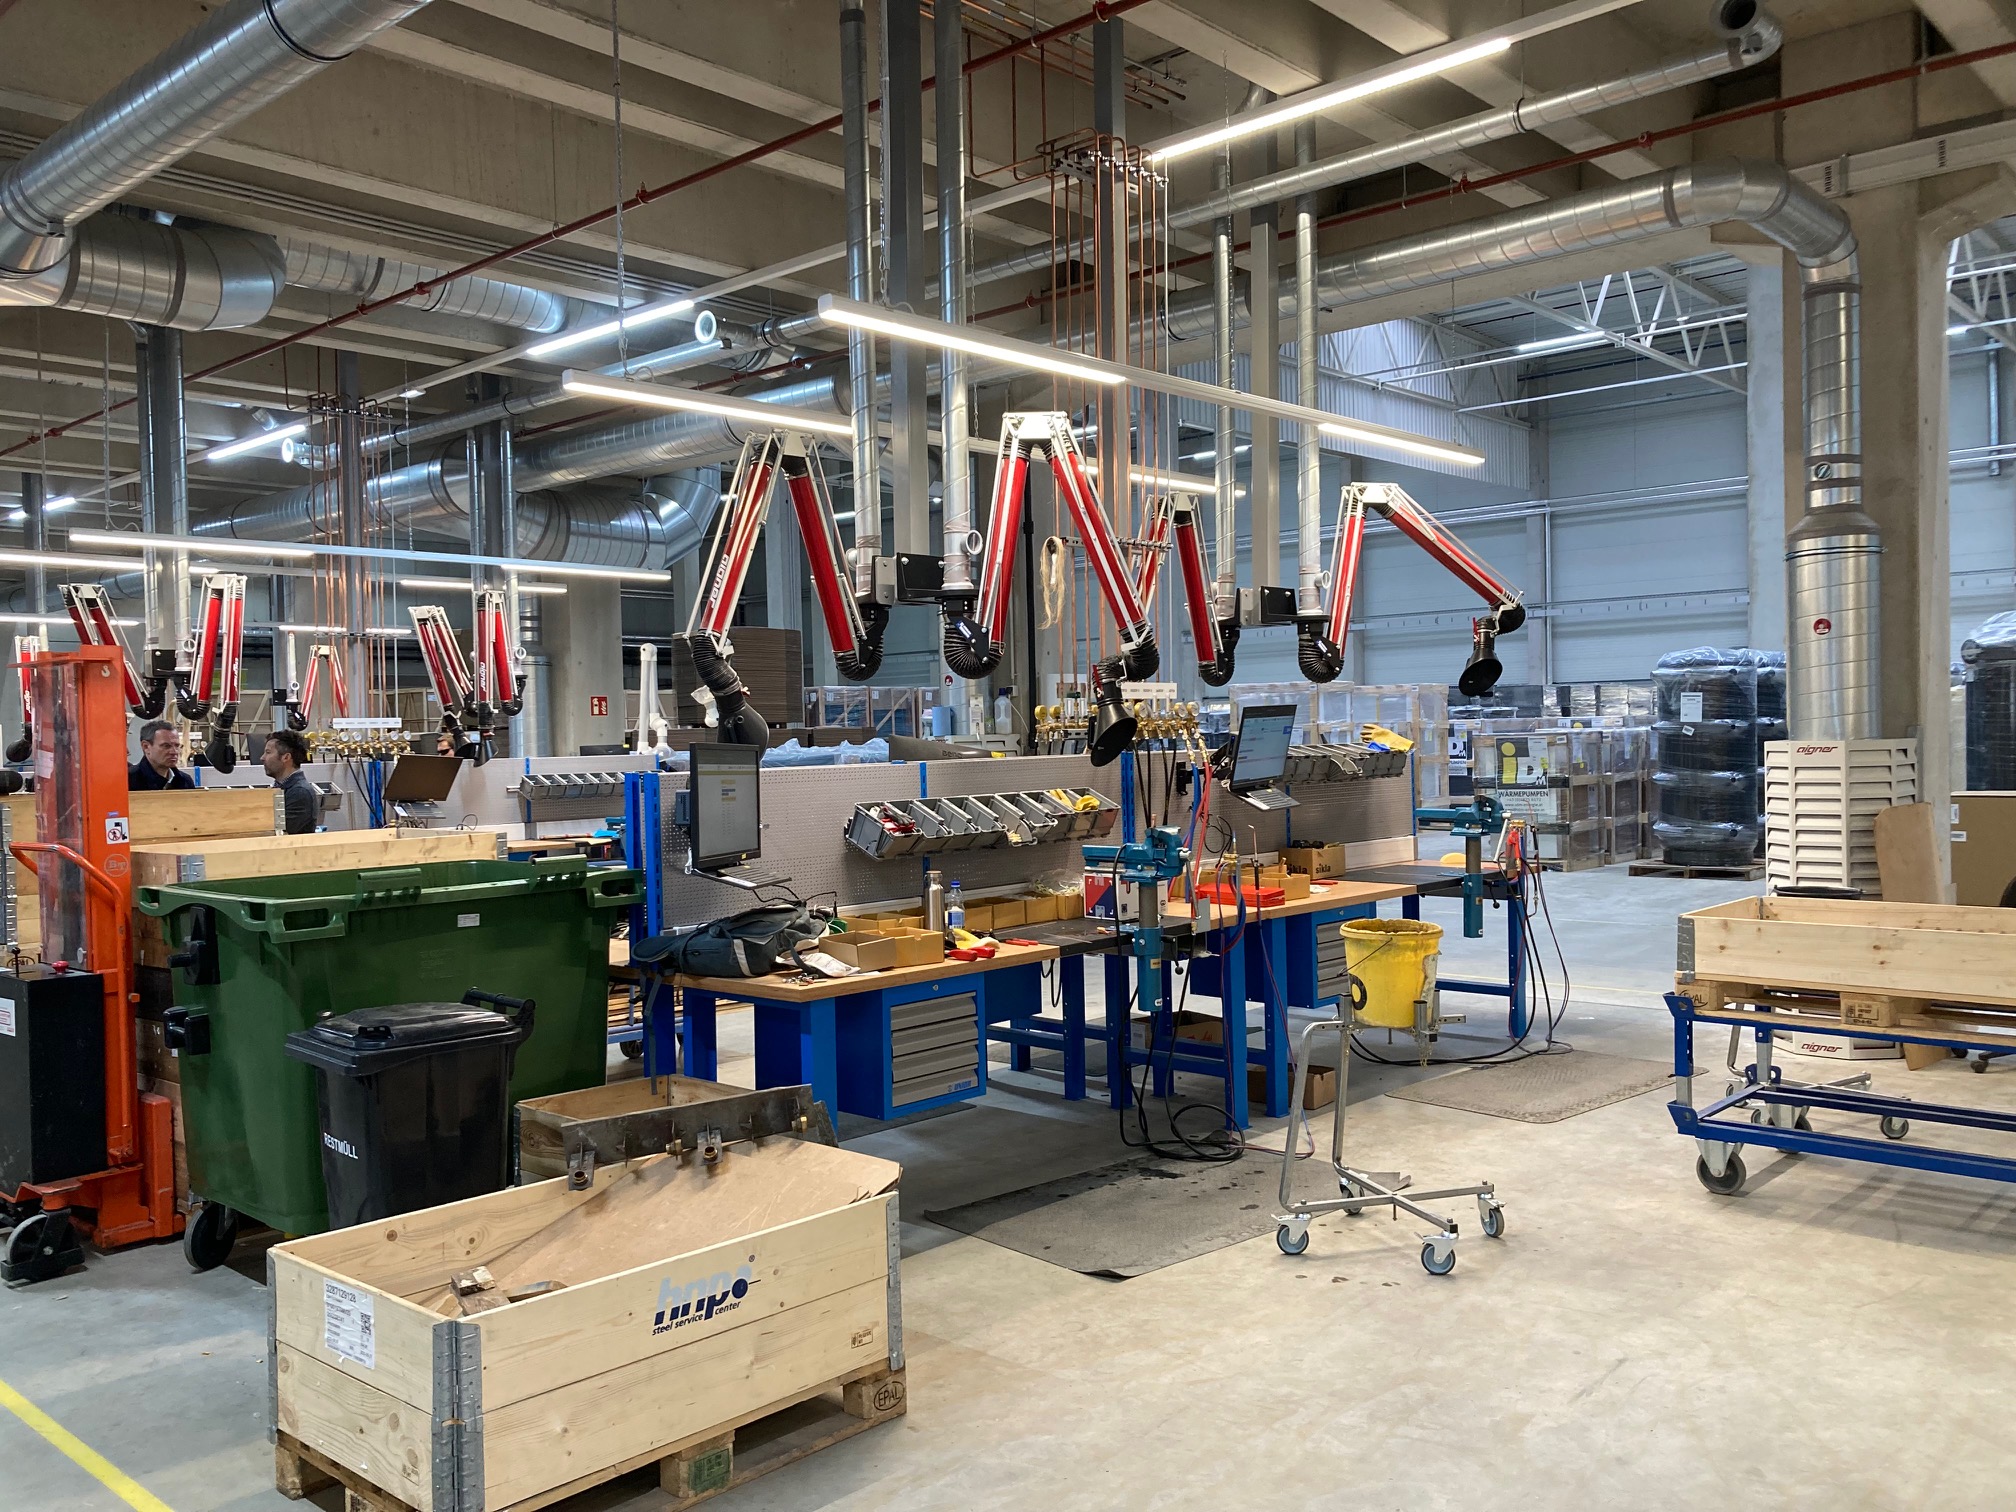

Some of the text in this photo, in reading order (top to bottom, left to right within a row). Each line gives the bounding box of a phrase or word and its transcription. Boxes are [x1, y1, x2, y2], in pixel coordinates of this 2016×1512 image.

[711, 553, 730, 609] aigner
[1796, 744, 1838, 755] aigner
[1315, 863, 1331, 874] sikla
[1801, 1042, 1843, 1053] aigner
[323, 1132, 358, 1160] RESTMÜLL
[652, 1301, 741, 1336] steel service center
[878, 1386, 901, 1408] EPAL
